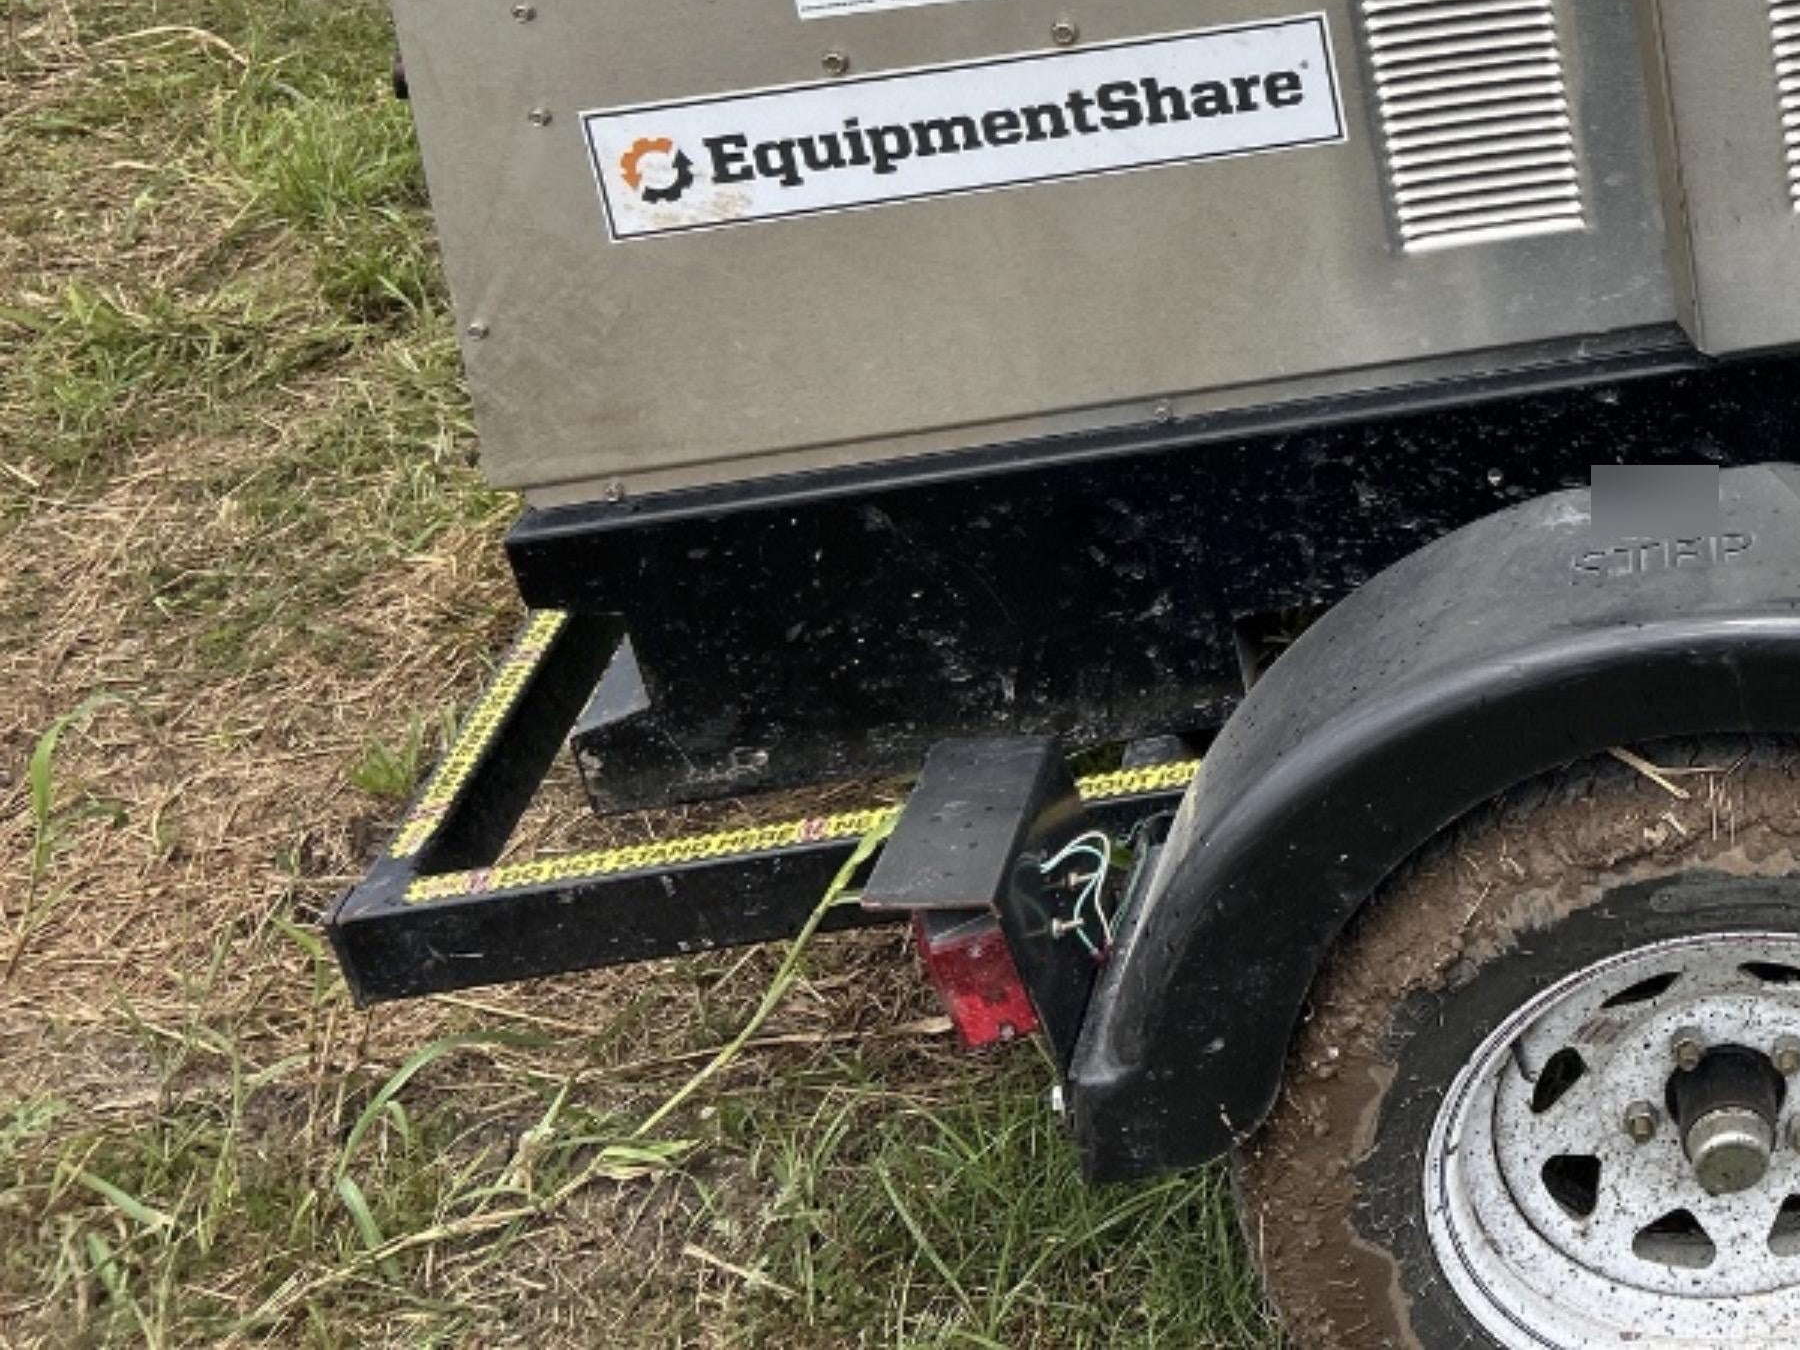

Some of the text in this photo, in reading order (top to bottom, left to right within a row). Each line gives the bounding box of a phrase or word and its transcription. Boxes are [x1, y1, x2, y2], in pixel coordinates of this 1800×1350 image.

[701, 64, 1305, 188] EquipmentShare
[501, 865, 546, 883] DO
[551, 853, 611, 874] NOT
